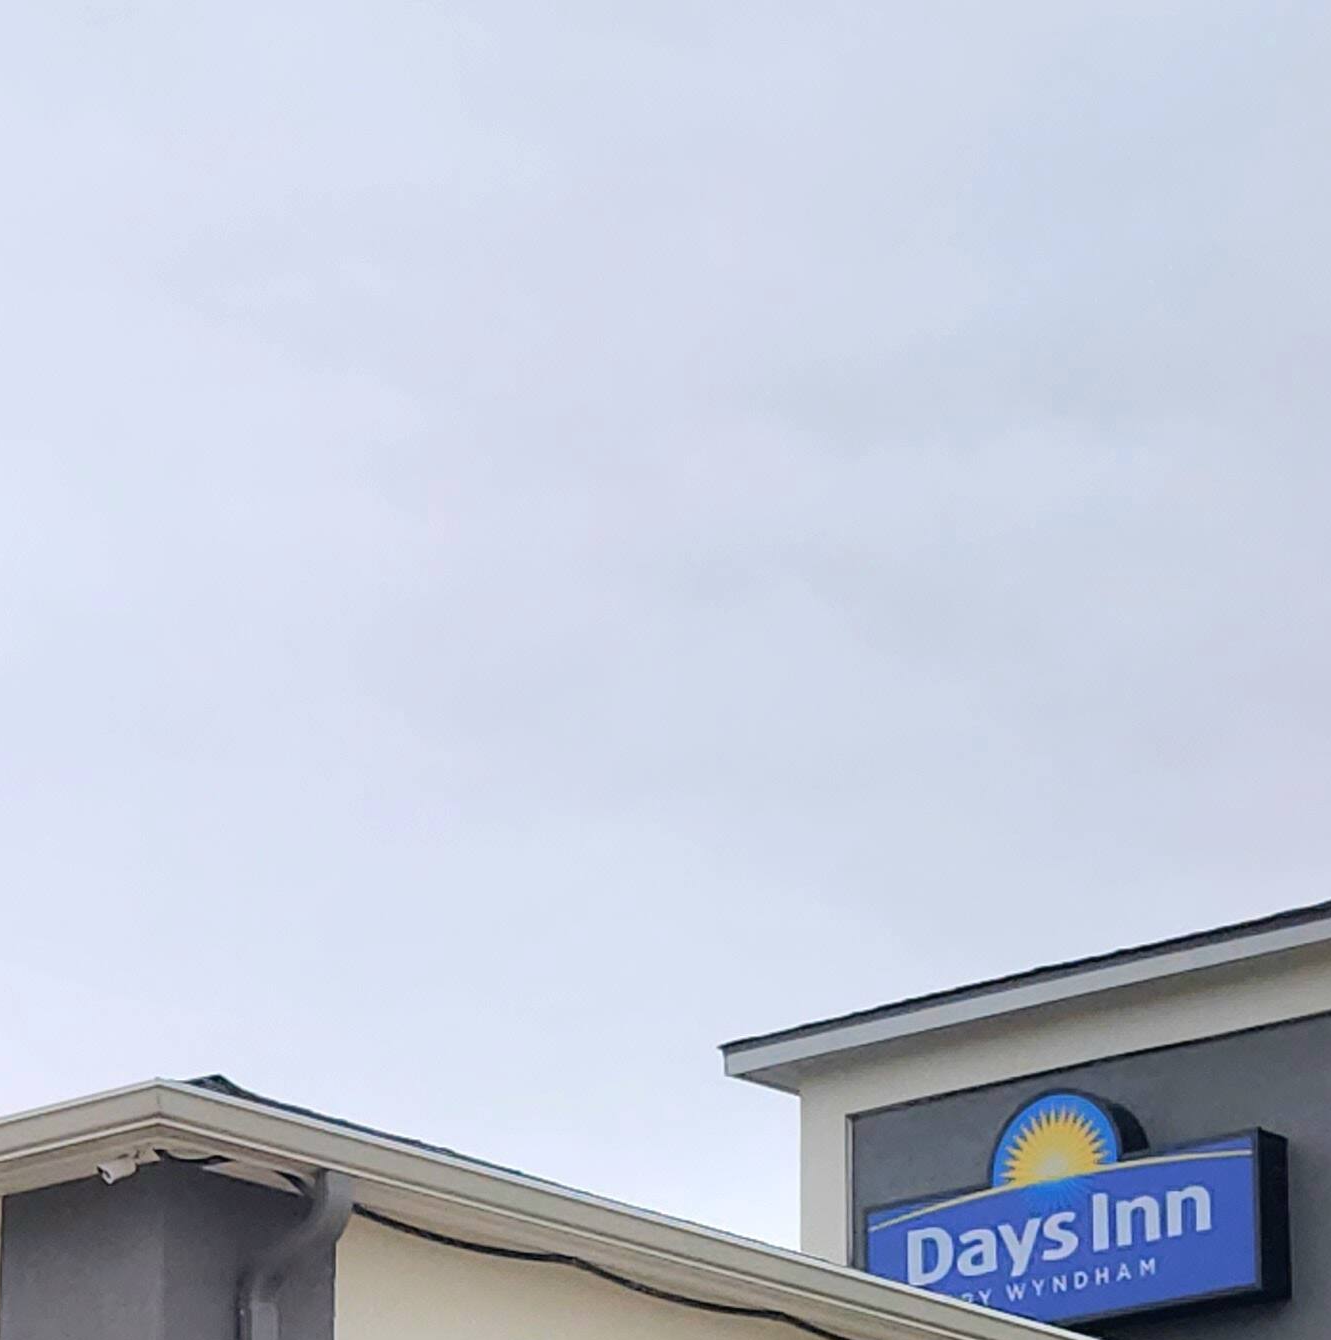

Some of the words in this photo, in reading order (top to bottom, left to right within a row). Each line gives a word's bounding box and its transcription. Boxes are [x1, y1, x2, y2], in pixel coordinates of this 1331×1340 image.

[907, 1211, 1078, 1286] Days
[1093, 1185, 1212, 1252] Inn
[1006, 1258, 1157, 1302] WYNDHAM
